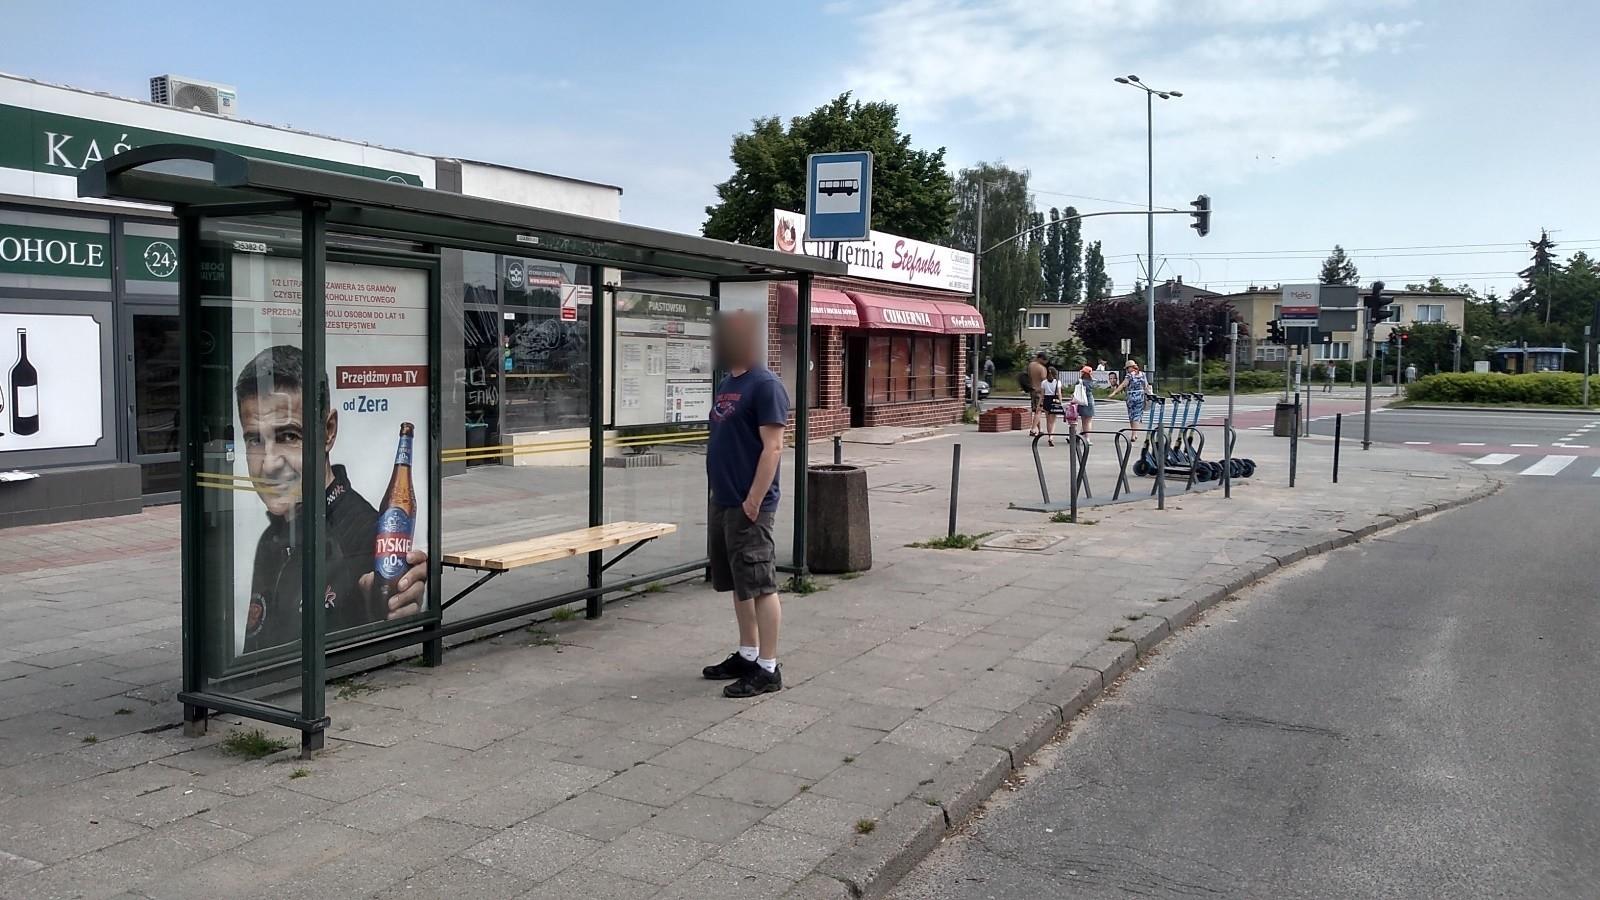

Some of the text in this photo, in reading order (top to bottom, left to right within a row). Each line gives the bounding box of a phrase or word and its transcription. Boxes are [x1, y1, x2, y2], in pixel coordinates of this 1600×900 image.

[44, 131, 137, 170] KAŚ
[152, 252, 170, 267] 24
[802, 232, 942, 280] Cuiernia Stefanka
[325, 283, 356, 291] ZAWIERA
[357, 284, 365, 292] 25
[366, 284, 397, 293] GRAMÓW
[273, 291, 301, 299] CZYSTE
[354, 295, 396, 304] ETYLOWEGO
[648, 301, 687, 313] PIASTOWSKA
[344, 310, 373, 319] OSOBOM
[374, 311, 384, 320] DO
[385, 312, 397, 320] LAT
[883, 308, 931, 326] CUKIERNIA
[951, 315, 980, 329] Stefanka
[341, 370, 418, 385] Przejdźmy na TY
[343, 395, 388, 412] od Zera
